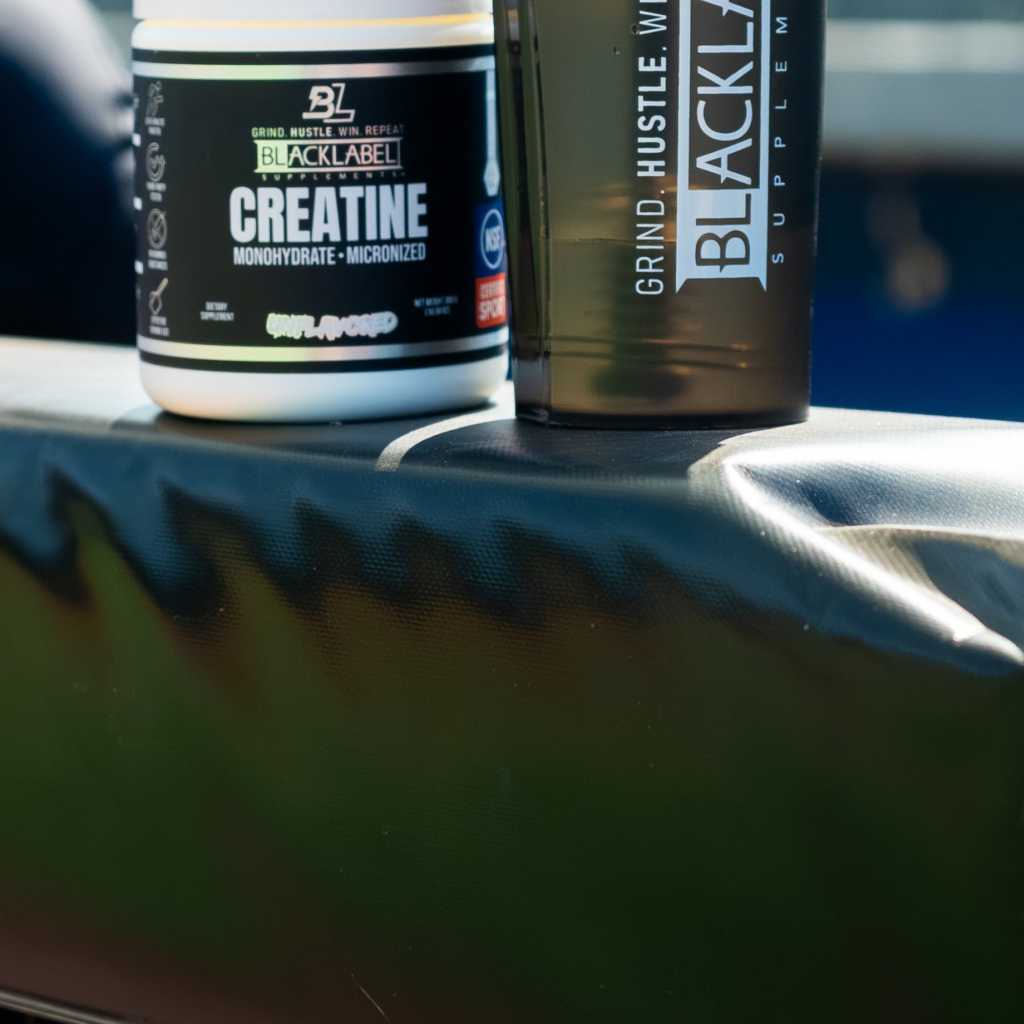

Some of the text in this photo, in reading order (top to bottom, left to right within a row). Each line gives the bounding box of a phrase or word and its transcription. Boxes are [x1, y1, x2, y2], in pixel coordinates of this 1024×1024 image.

[364, 124, 404, 136] REPEAT
[262, 143, 397, 167] BLACKLABEL
[229, 183, 428, 243] CREATINE
[233, 242, 426, 266] MONOHYDRATE MICRONIZED
